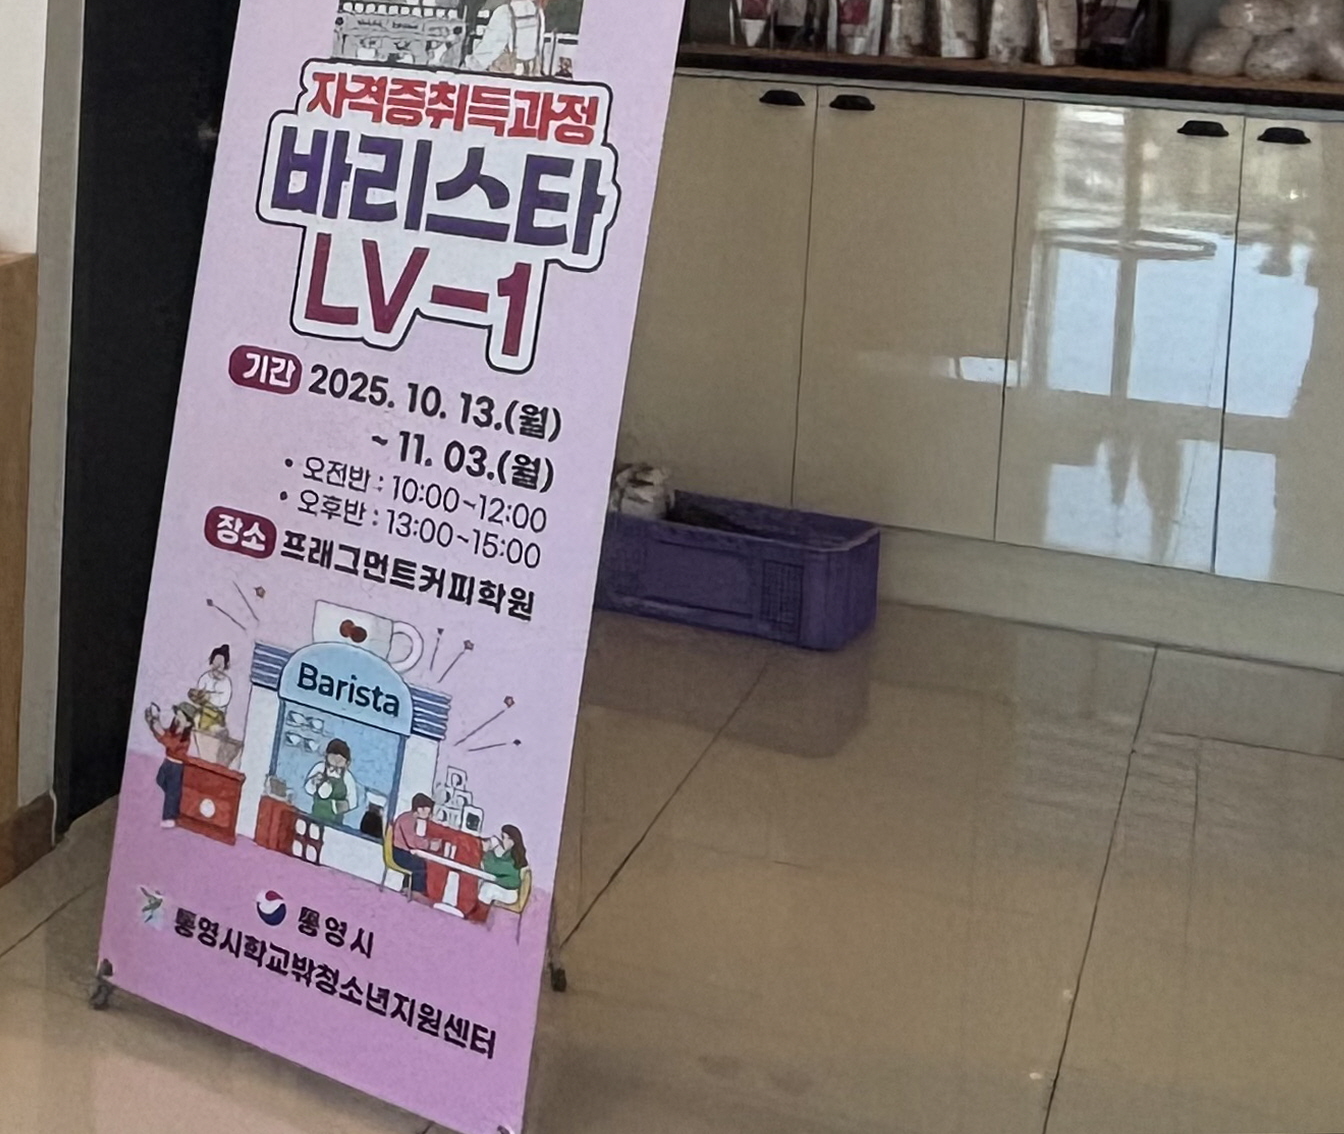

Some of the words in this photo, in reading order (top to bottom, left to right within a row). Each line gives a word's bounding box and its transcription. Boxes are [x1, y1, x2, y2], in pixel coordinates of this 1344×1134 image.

[307, 70, 600, 146] 자격증취득과정
[269, 125, 606, 256] 바리스타
[303, 232, 533, 358] LV-1
[242, 352, 296, 388] 기간
[308, 364, 395, 409] 2025.
[407, 382, 447, 419] 10.
[460, 391, 562, 442] 13.(월)
[302, 456, 371, 493] 오전반
[392, 475, 548, 534] 10:00~12:00
[399, 430, 433, 467] 11.
[443, 440, 555, 493] 03.(월)
[216, 514, 267, 552] 장소
[280, 529, 536, 623] 프래그먼트커피학원
[297, 489, 366, 527] 오후반
[386, 509, 542, 569] 13:00~15:00
[296, 661, 401, 718] Barista
[297, 905, 376, 959] 통영시
[174, 906, 497, 1060] 통영시학교밖청소년지원센터
